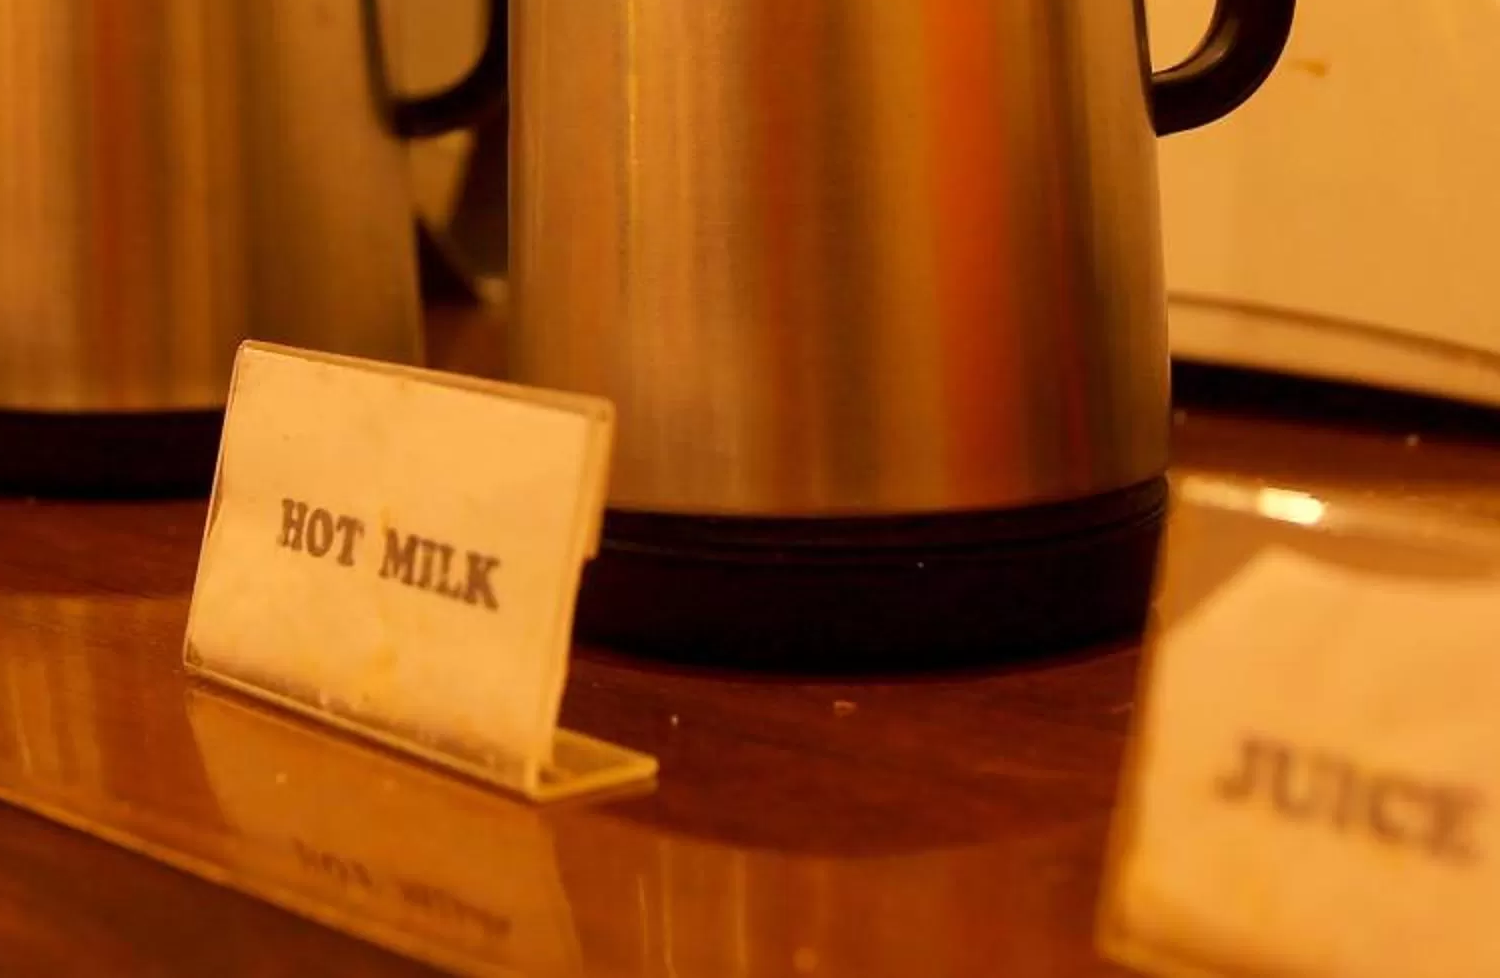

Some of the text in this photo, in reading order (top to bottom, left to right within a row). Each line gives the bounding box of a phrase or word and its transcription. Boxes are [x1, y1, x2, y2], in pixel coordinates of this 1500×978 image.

[277, 498, 502, 612] HOT MILK
[1212, 734, 1488, 869] JUICE
